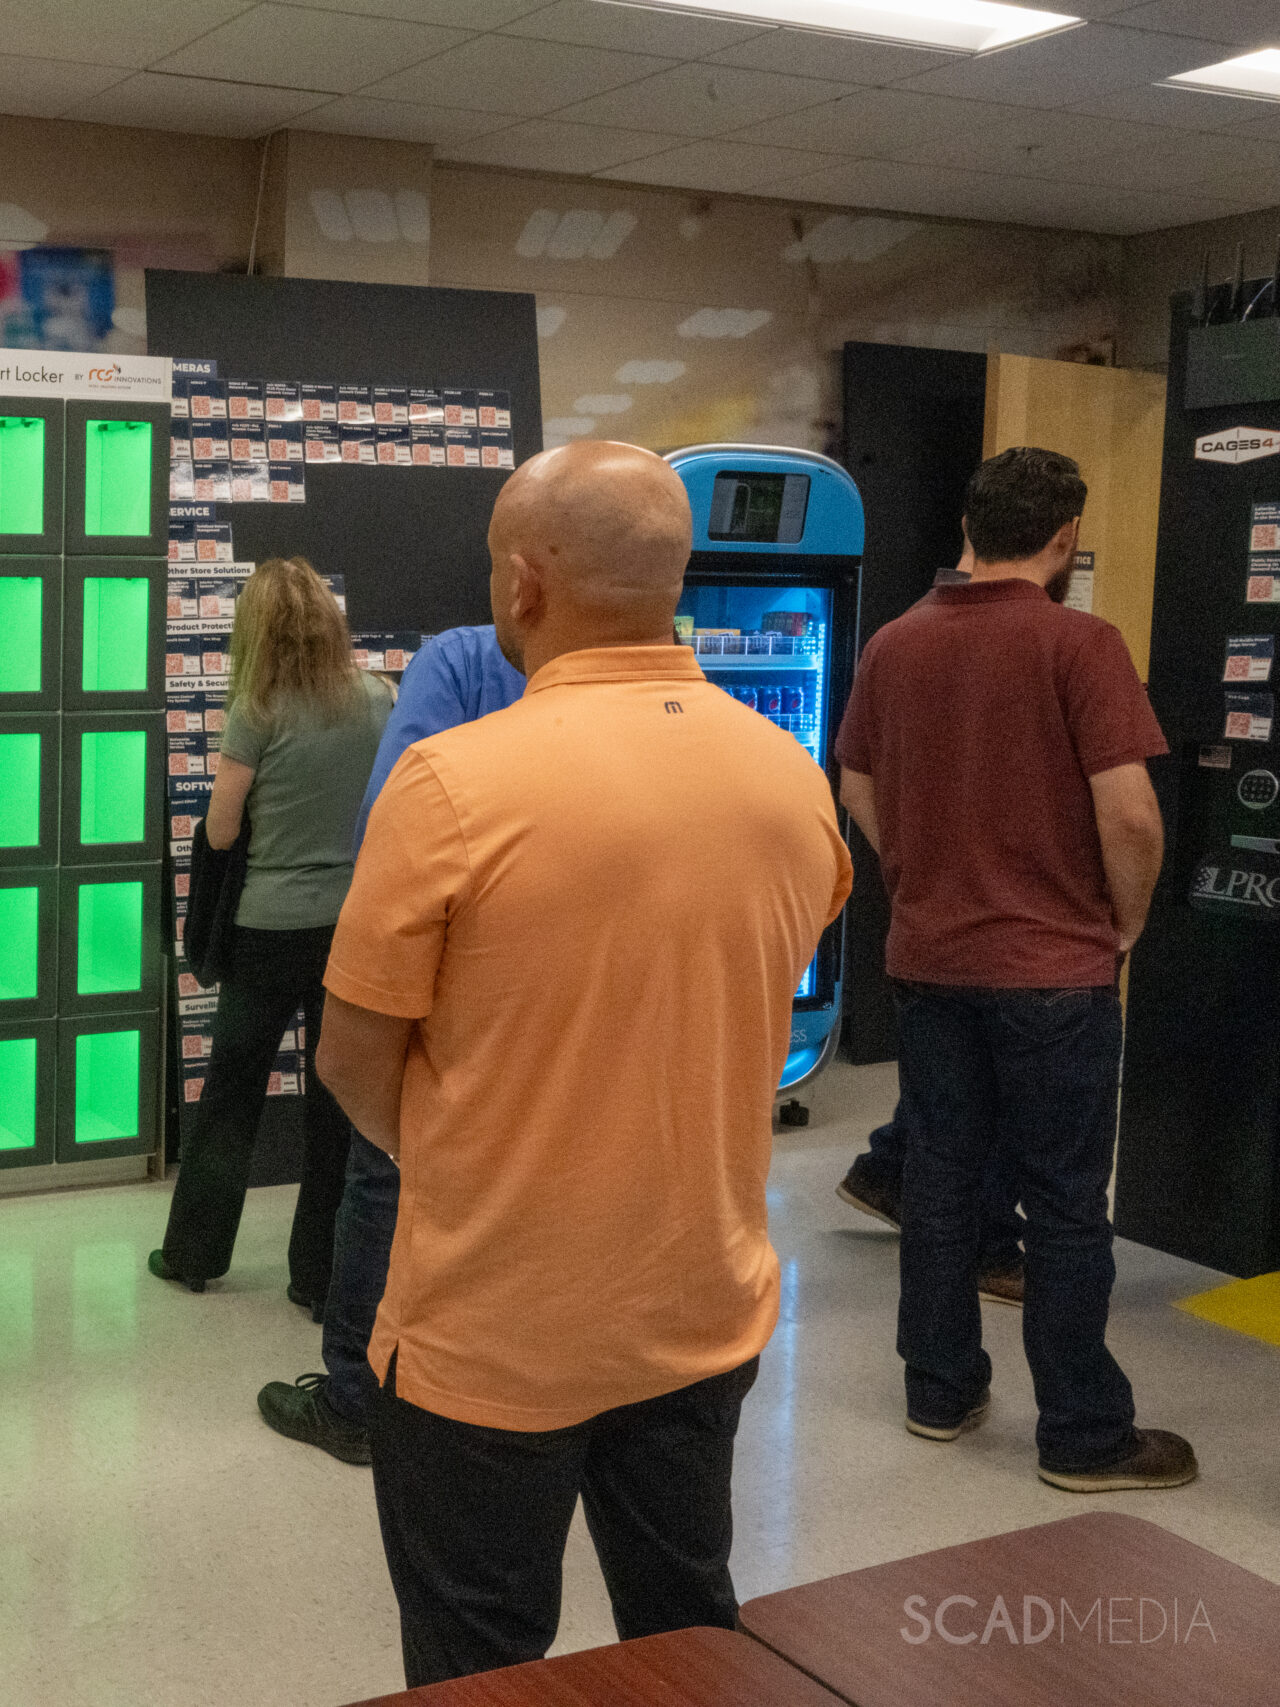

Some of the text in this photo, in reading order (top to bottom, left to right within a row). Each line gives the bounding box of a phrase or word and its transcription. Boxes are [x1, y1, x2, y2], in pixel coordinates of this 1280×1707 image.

[172, 363, 211, 374] MERAS
[15, 365, 65, 384] Locker
[114, 376, 162, 385] INNOVATIONS
[1201, 438, 1274, 453] CAGES4
[169, 507, 210, 517] ERVICE
[1074, 555, 1092, 565] TICE
[190, 567, 212, 575] Store
[213, 566, 251, 574] Solutions
[201, 622, 234, 630] Protecti
[169, 680, 195, 688] Safety
[175, 781, 215, 792] SOFTW
[176, 844, 193, 852] Oth
